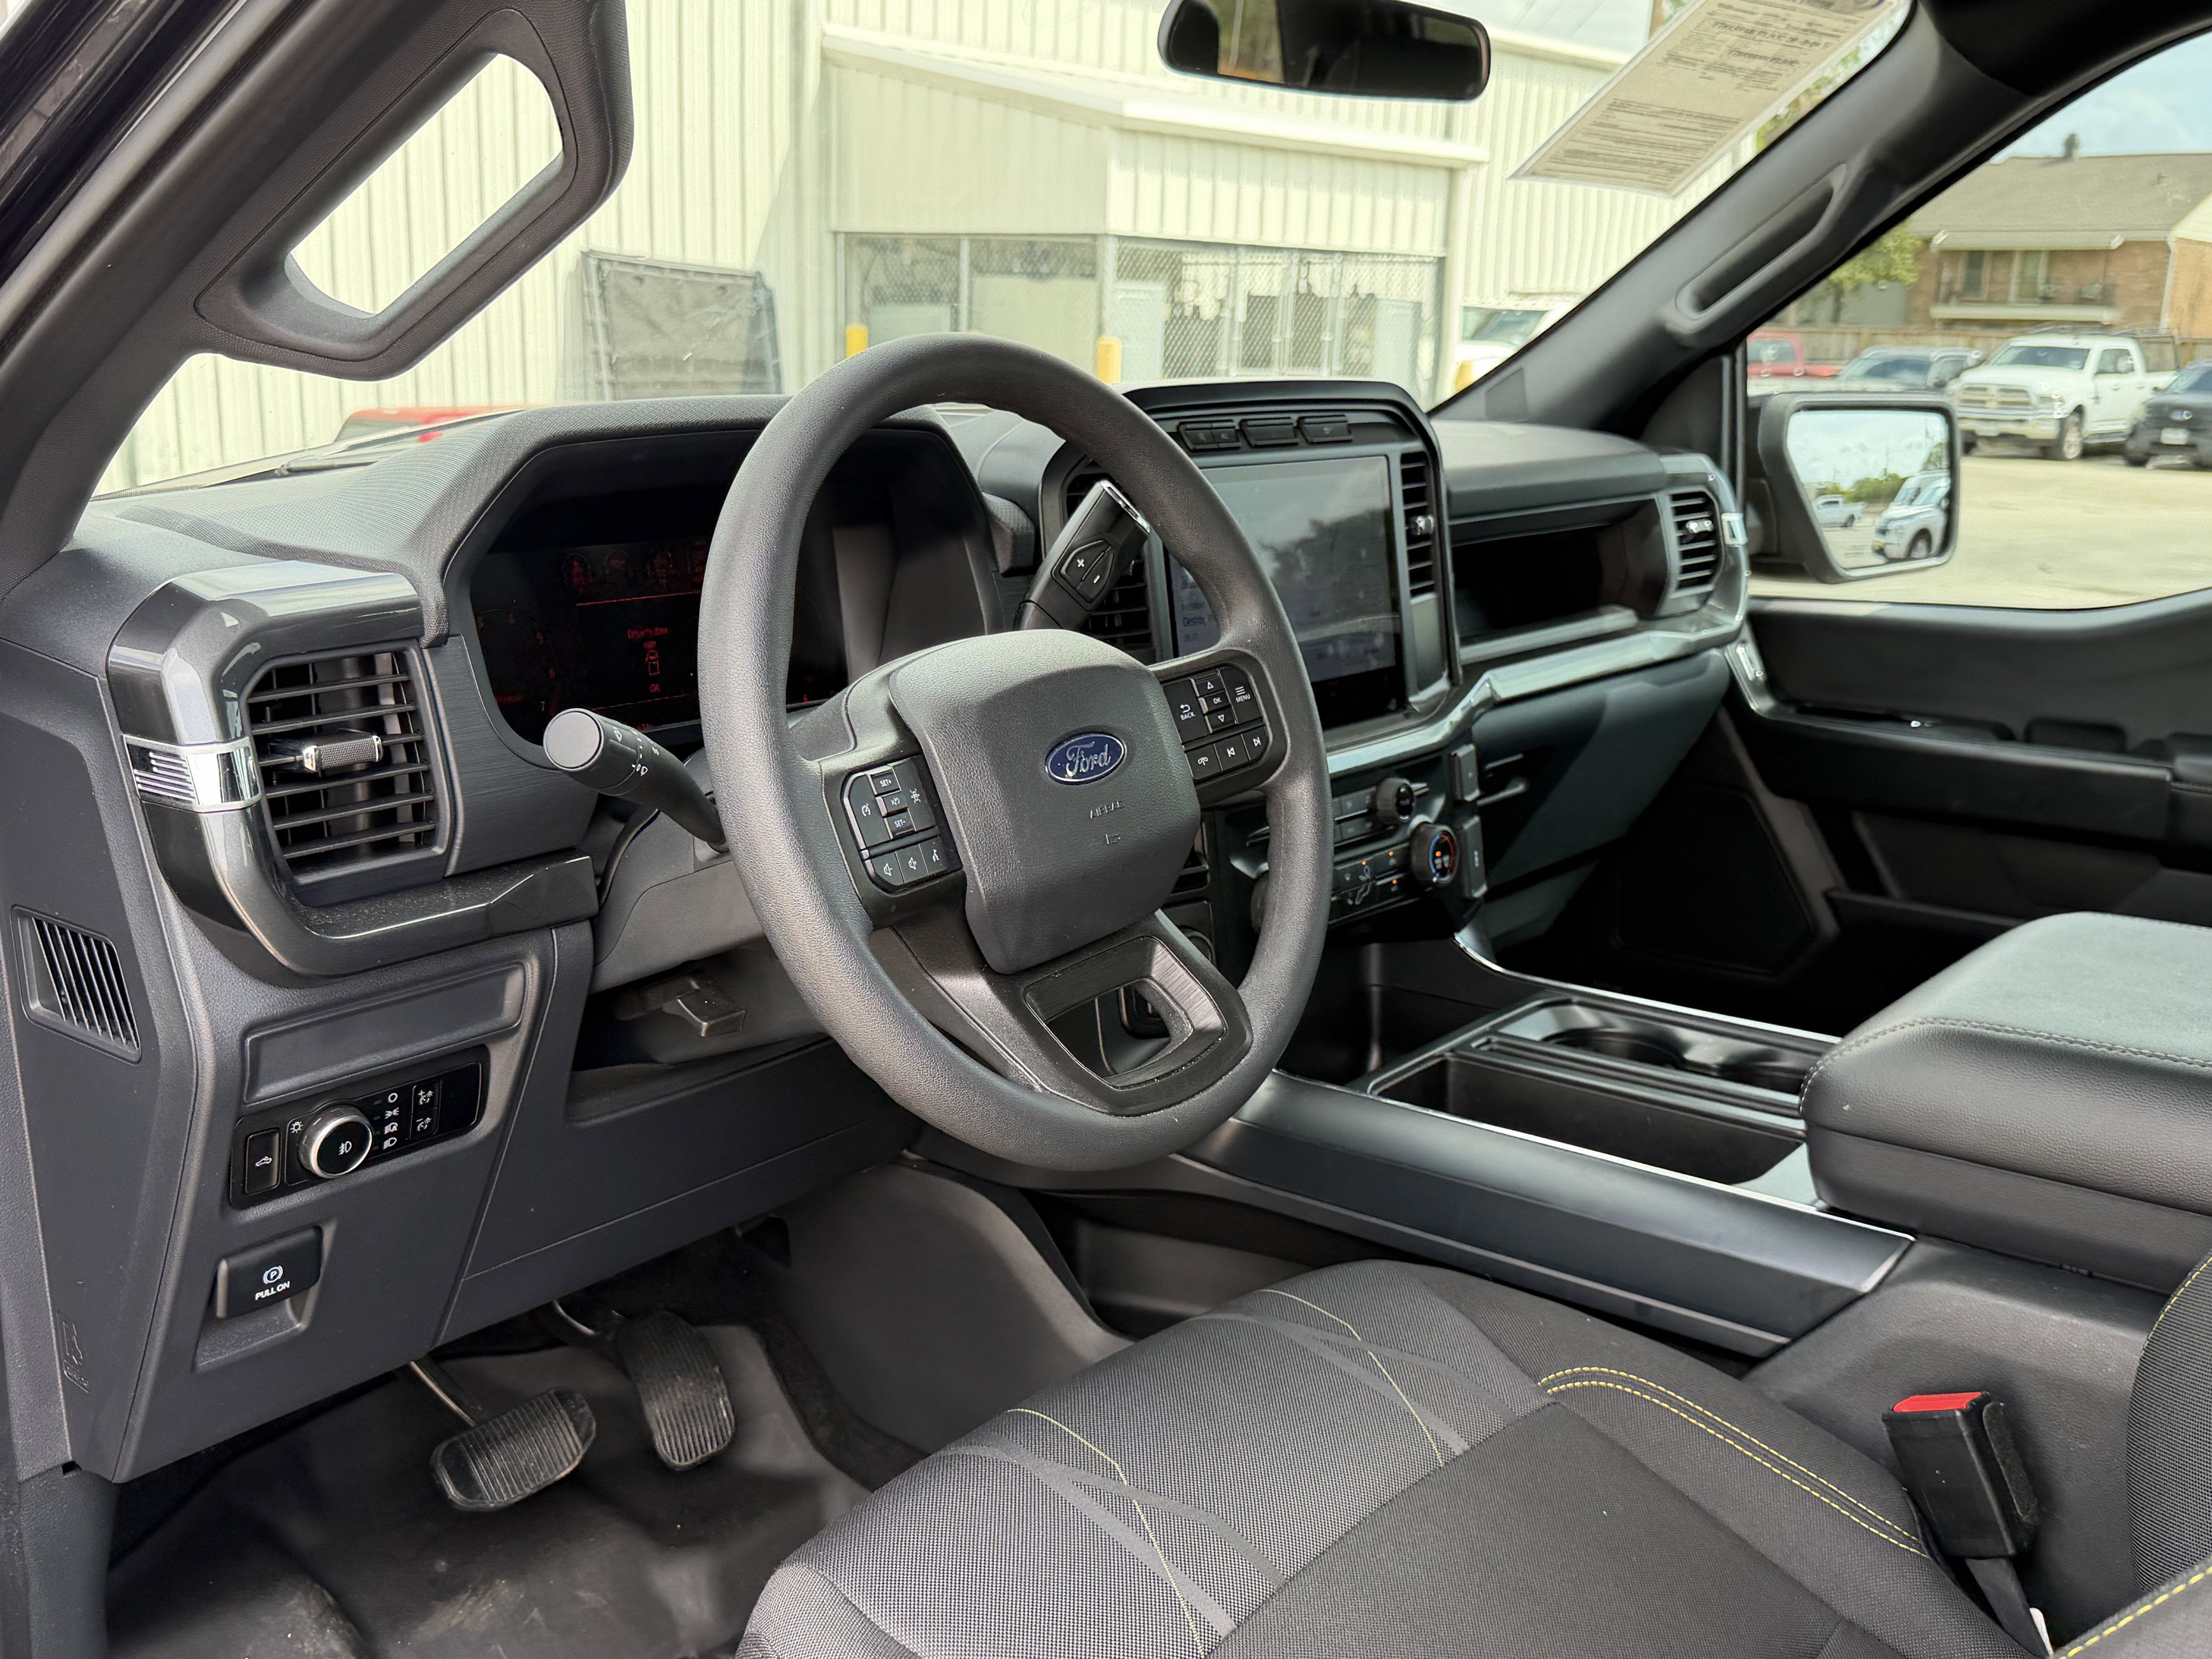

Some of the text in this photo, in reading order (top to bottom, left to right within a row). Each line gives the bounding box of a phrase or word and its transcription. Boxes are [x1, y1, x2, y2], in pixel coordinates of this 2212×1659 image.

[1235, 694, 1250, 703] MENU
[1180, 712, 1195, 721] BACK
[1066, 741, 1111, 776] Ford
[880, 779, 892, 787] SET+
[271, 1271, 277, 1279] P
[255, 1281, 290, 1300] PULL ON
